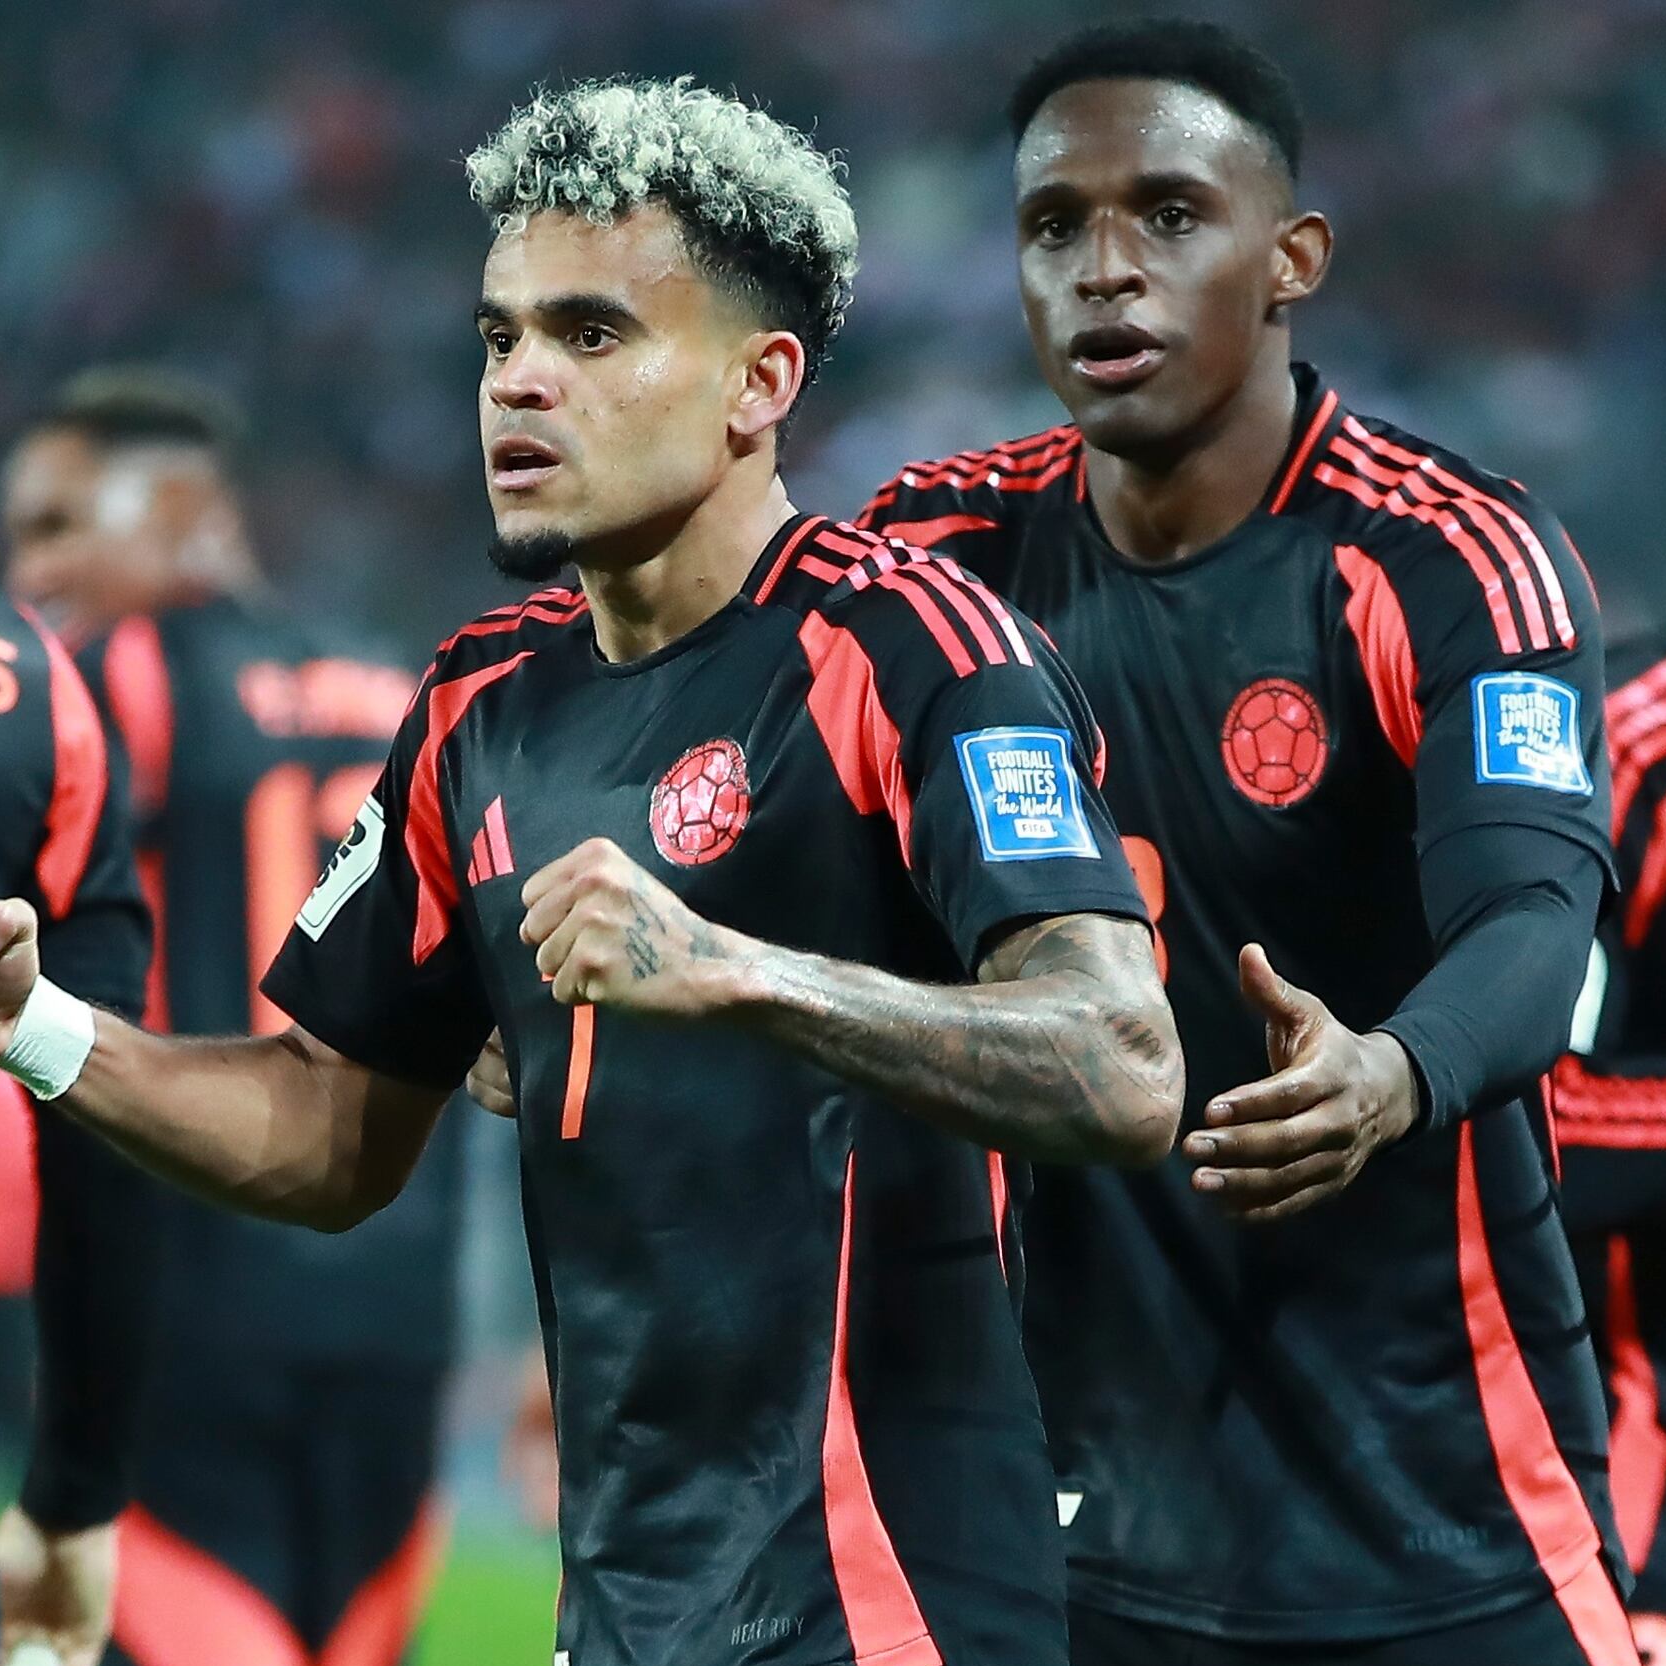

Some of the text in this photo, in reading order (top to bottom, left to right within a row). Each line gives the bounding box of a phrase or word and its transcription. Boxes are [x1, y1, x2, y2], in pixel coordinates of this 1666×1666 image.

[987, 750, 1054, 770] FOOTBALL
[991, 768, 1057, 796] UNITES
[993, 794, 1063, 819] the World
[1021, 823, 1047, 834] FIFA
